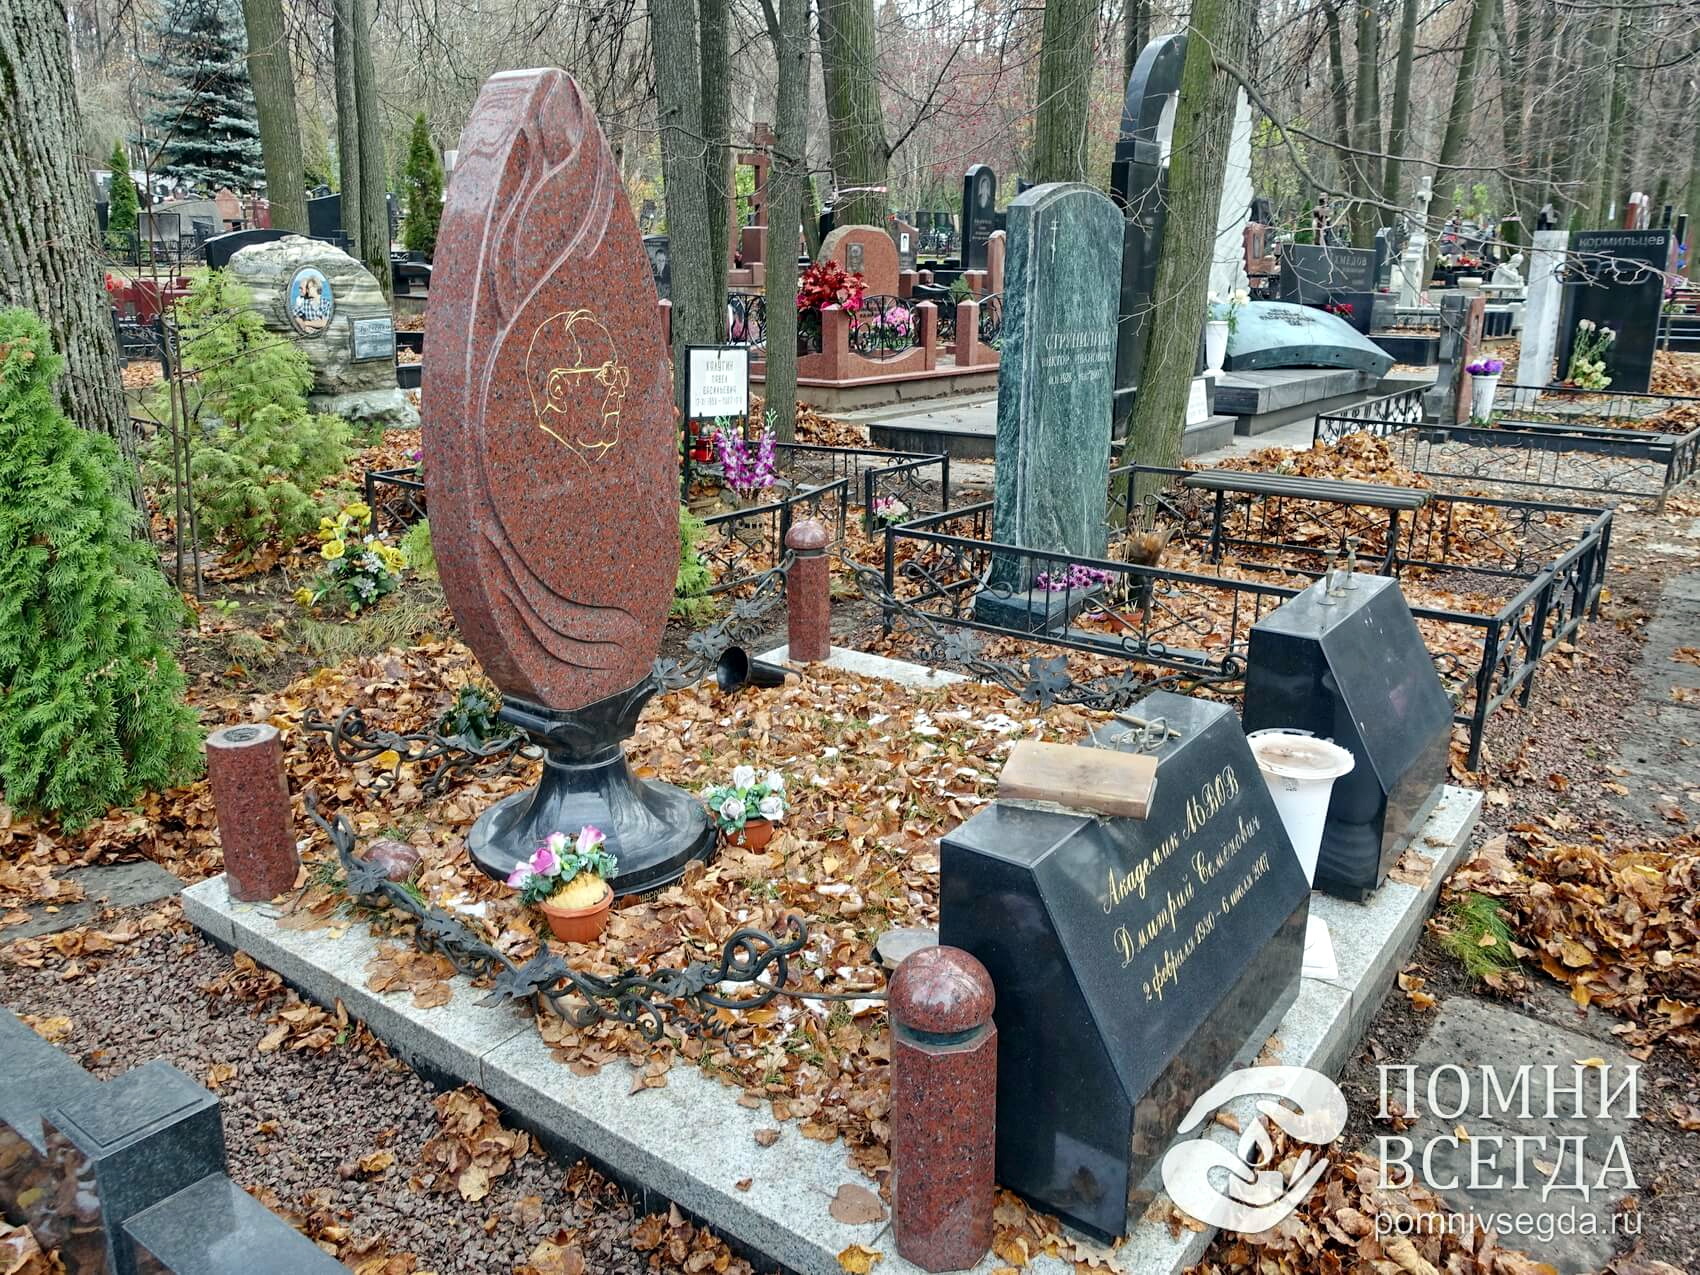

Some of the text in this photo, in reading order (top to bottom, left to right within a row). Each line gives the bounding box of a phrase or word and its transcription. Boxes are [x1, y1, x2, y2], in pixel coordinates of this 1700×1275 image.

[1330, 254, 1367, 266] ХМЕДОВ
[1578, 234, 1665, 249] кормильцев
[1041, 351, 1110, 368] ВИКТОР ИВАНОВИЧ
[1103, 832, 1180, 914] Академик
[1113, 815, 1261, 969] Дмитрий Семёнович
[1142, 981, 1153, 1002] 2
[1152, 936, 1196, 1001] февраля
[1194, 911, 1216, 945] 1930
[1221, 895, 1230, 914] 6
[1230, 873, 1253, 907] июля
[1253, 850, 1270, 882] 2007
